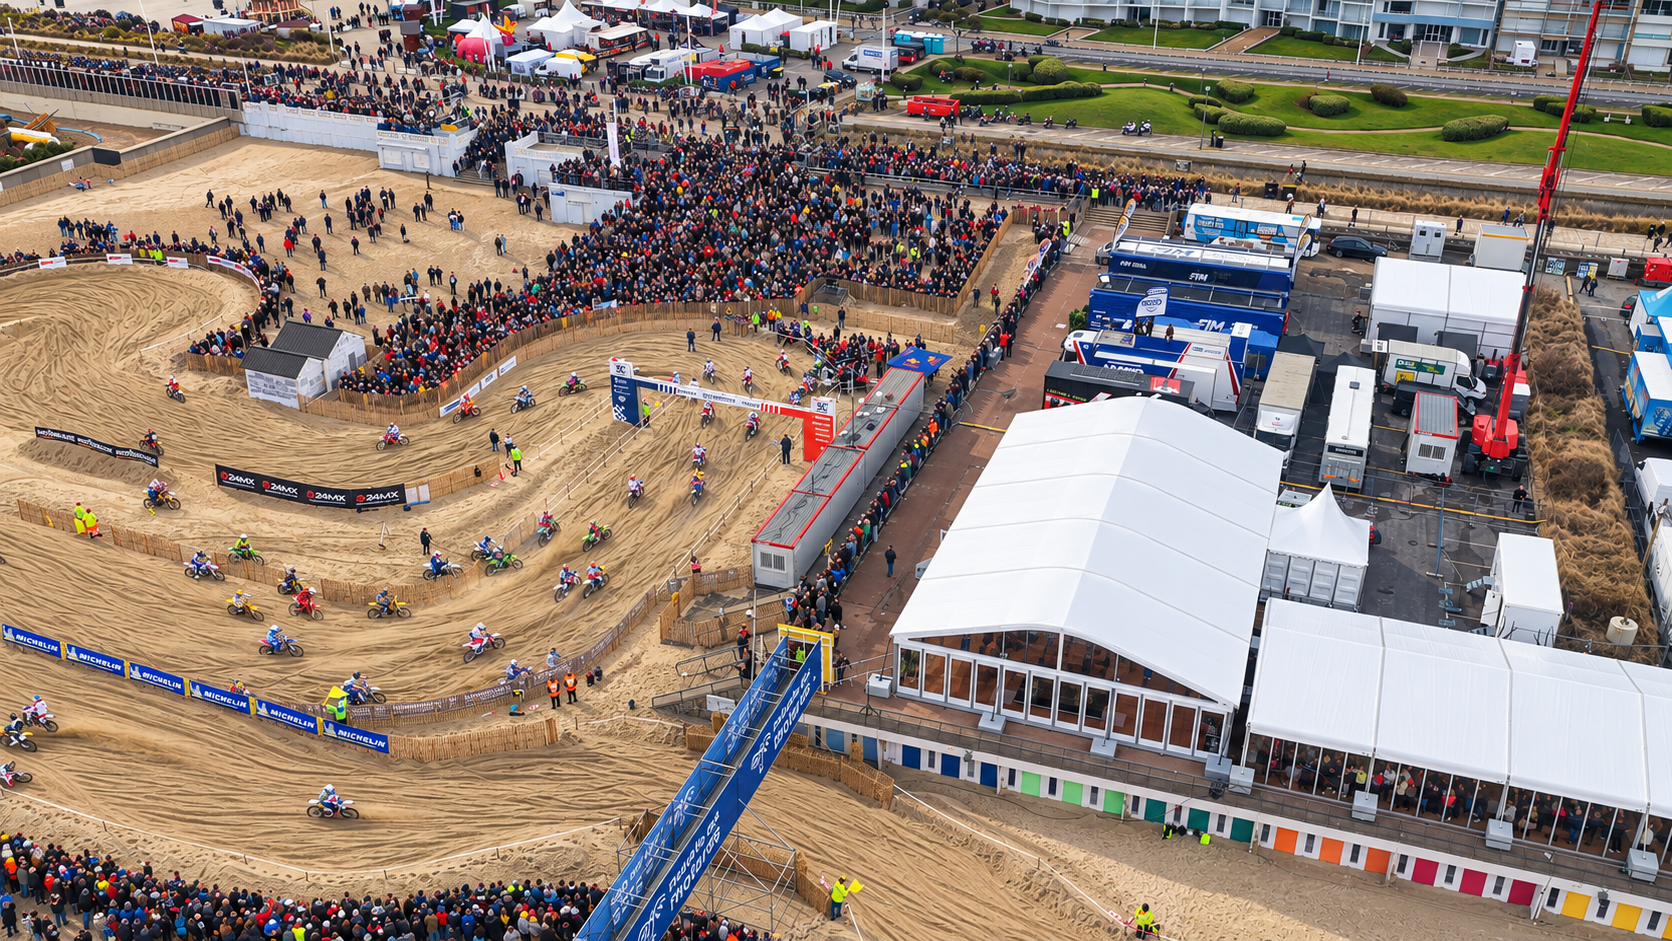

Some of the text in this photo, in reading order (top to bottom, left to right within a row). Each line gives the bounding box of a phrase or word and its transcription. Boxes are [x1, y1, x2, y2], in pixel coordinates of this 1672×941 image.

[1196, 318, 1226, 333] FIM
[228, 473, 255, 487] 24MX
[270, 482, 298, 496] 24MX
[365, 490, 399, 502] 24MX
[314, 491, 346, 502] 24MX
[203, 690, 247, 709] MICHELIN
[270, 709, 315, 729] MICHELIN
[337, 728, 387, 749] MICHELIN
